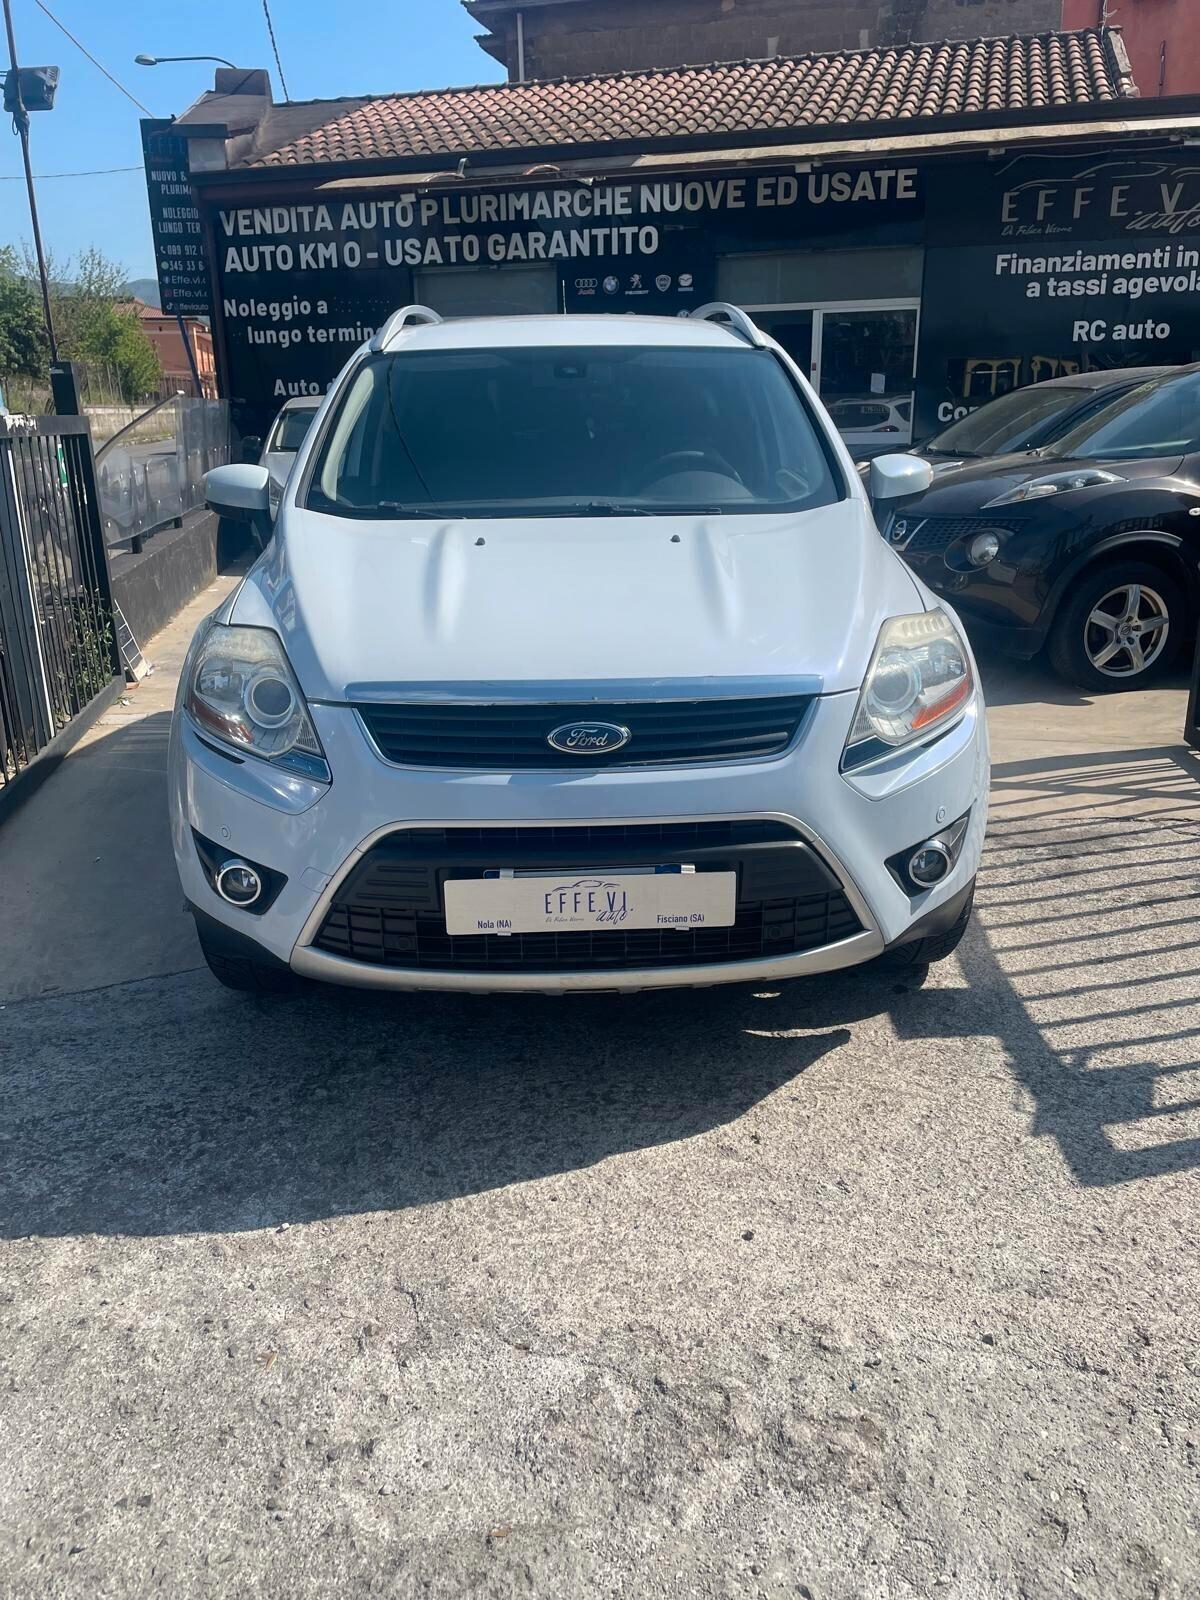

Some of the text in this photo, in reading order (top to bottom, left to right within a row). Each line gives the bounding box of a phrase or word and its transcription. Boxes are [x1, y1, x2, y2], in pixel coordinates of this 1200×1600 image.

[151, 170, 177, 181] NUOVO
[219, 168, 918, 237] VENDITA AUTO PLURIMARCHE NUOVE ED USATE
[162, 207, 199, 219] NOLEGGIO
[158, 222, 183, 234] LUNGO
[185, 244, 197, 256] 912
[224, 245, 294, 273] AUTO
[300, 242, 338, 270] KM
[366, 251, 379, 260] -
[385, 234, 480, 266] USATO
[487, 226, 659, 260] GARANTITO
[169, 261, 183, 271] 345
[186, 261, 196, 271] 33
[996, 245, 1199, 275] Finanziamenti in
[1026, 280, 1040, 297] a
[1047, 273, 1108, 296] tassi
[224, 295, 328, 322] Noleggio a
[248, 326, 302, 348] lungo
[1072, 319, 1171, 342] RC auto
[274, 378, 319, 396] Auto
[566, 728, 609, 746] Ford
[477, 919, 512, 929] Nola (NA)
[596, 905, 627, 925] auto
[656, 913, 705, 923] Fisciano (SA)
